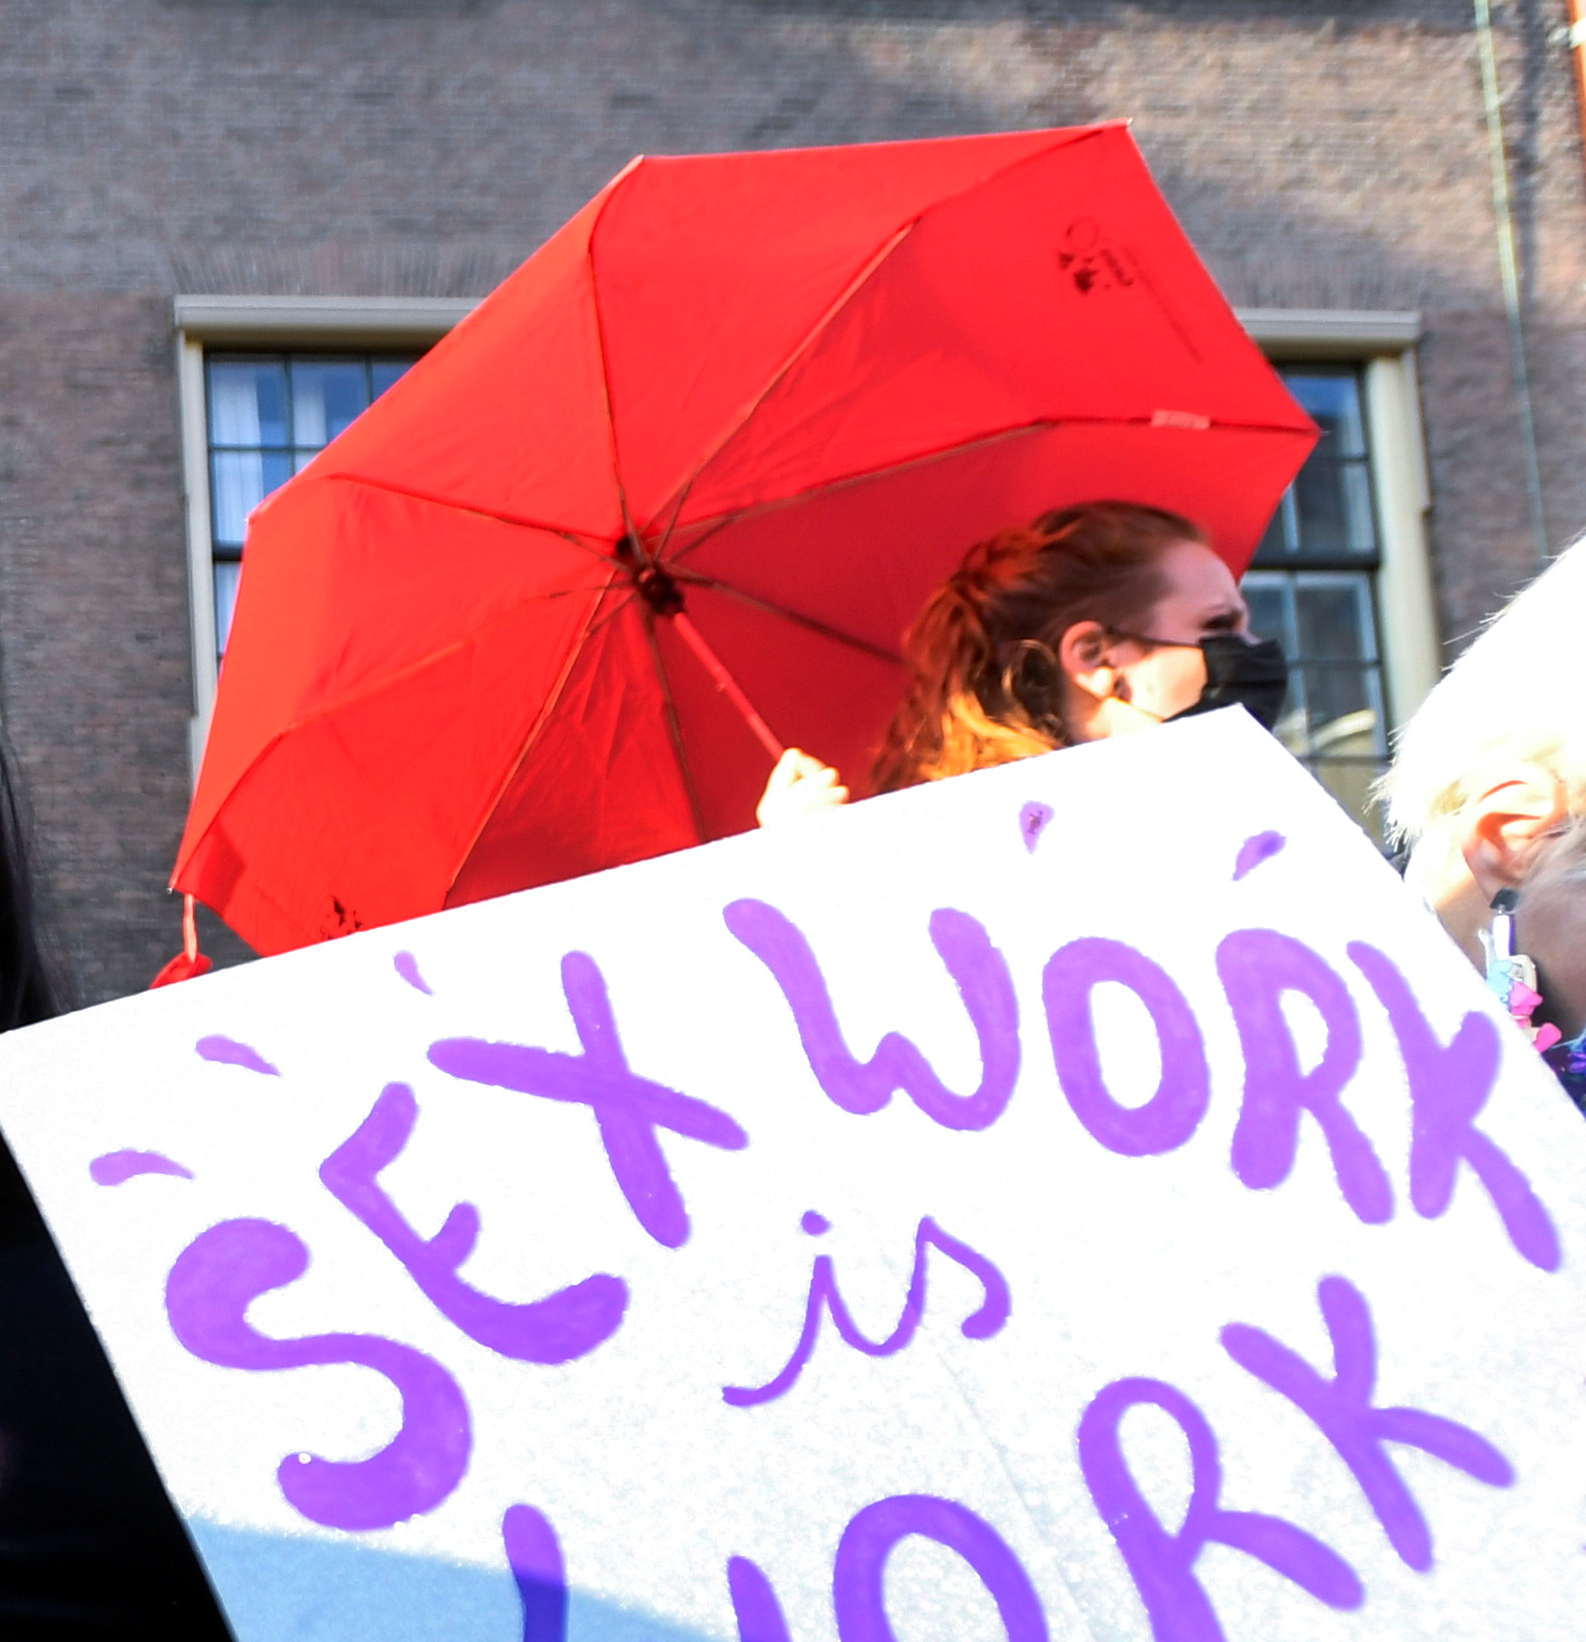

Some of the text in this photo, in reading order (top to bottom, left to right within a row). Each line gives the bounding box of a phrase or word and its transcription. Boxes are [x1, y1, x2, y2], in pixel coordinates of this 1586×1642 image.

[165, 899, 1561, 1533] SEX WORK
[722, 1210, 1012, 1409] is
